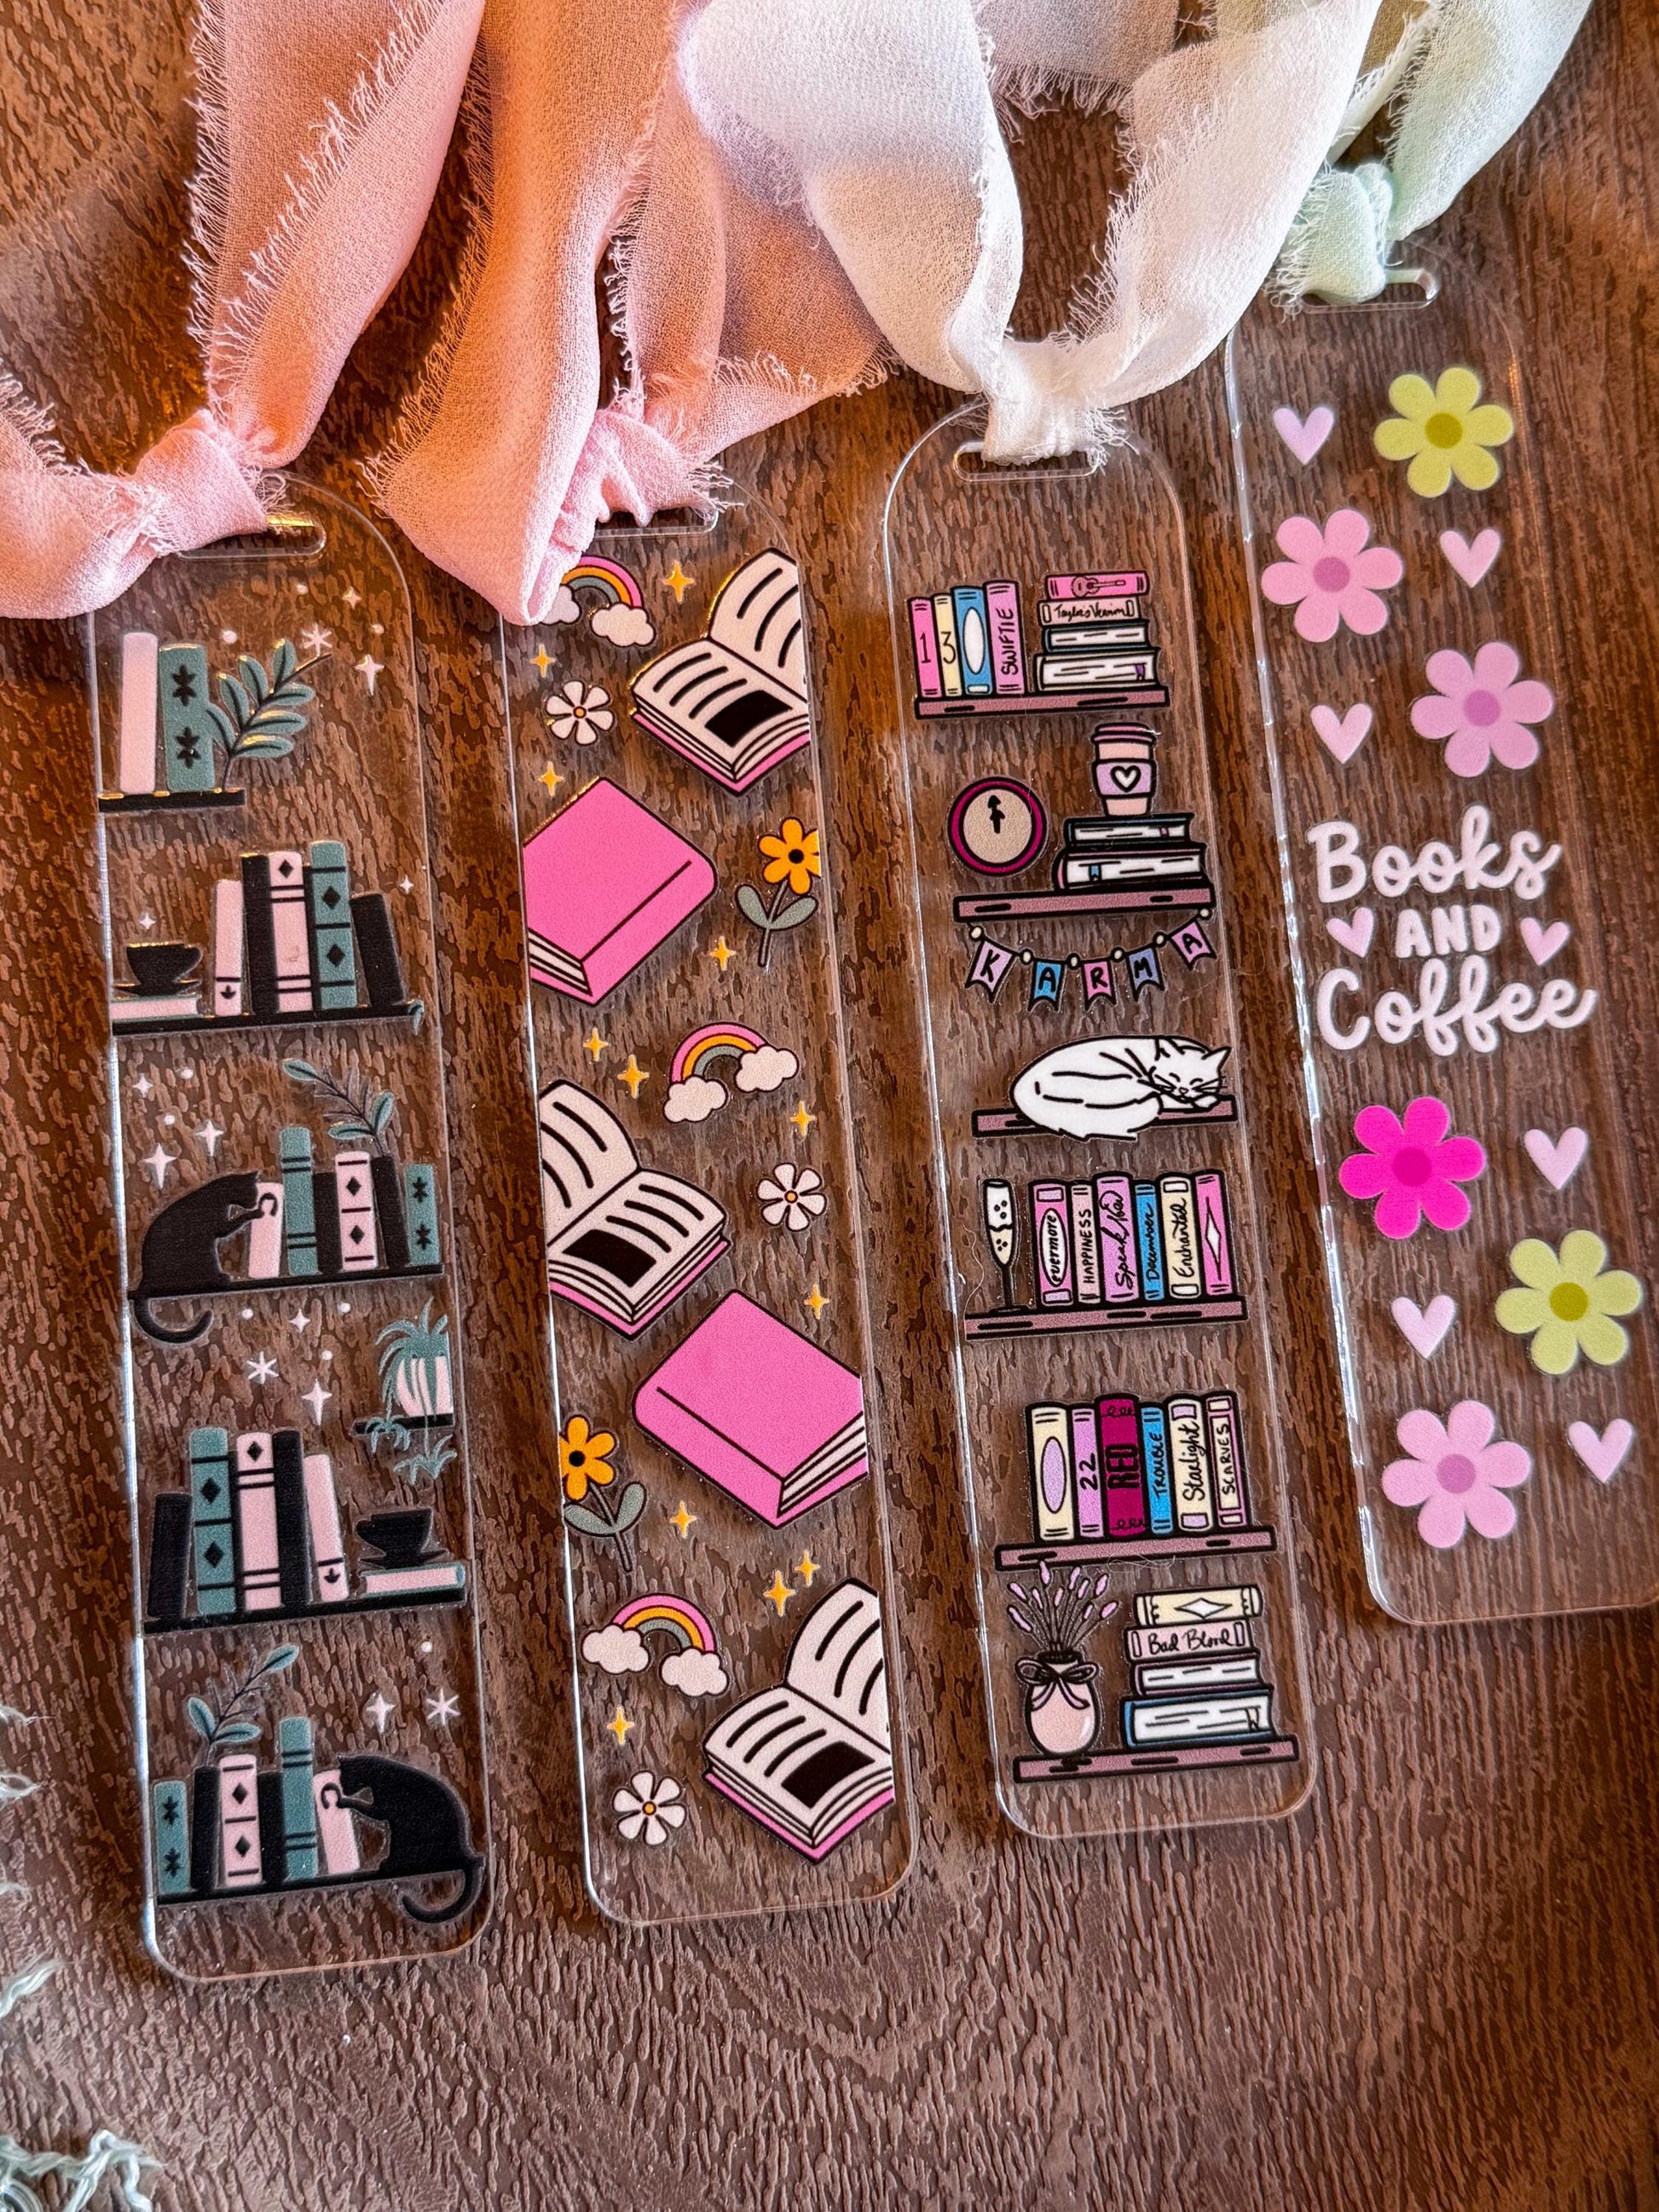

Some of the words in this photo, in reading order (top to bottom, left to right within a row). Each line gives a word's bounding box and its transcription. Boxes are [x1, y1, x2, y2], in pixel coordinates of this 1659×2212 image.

[1001, 607, 1019, 676] SWIFTIE
[1054, 604, 1091, 622] Taylor's
[1090, 602, 1127, 619] Version
[1306, 805, 1562, 903] Books
[980, 933, 1203, 993] KARMA
[1395, 904, 1501, 958] AND
[1317, 955, 1598, 1056] Coffee
[1078, 1208, 1095, 1285] HAPPINESS
[1099, 1190, 1130, 1239] Now
[1145, 1202, 1160, 1282] December
[1170, 1197, 1194, 1278] Enchanted
[1046, 1215, 1061, 1282] evermore
[1101, 1227, 1136, 1291] Speak
[1079, 1453, 1098, 1491] 22
[1105, 1444, 1140, 1490] RED
[1151, 1432, 1168, 1499] TROUBLE
[1177, 1418, 1207, 1502] Starlight
[1216, 1424, 1236, 1495] SCARVES
[1148, 1633, 1180, 1655] Bad
[1182, 1628, 1234, 1651] Blood
